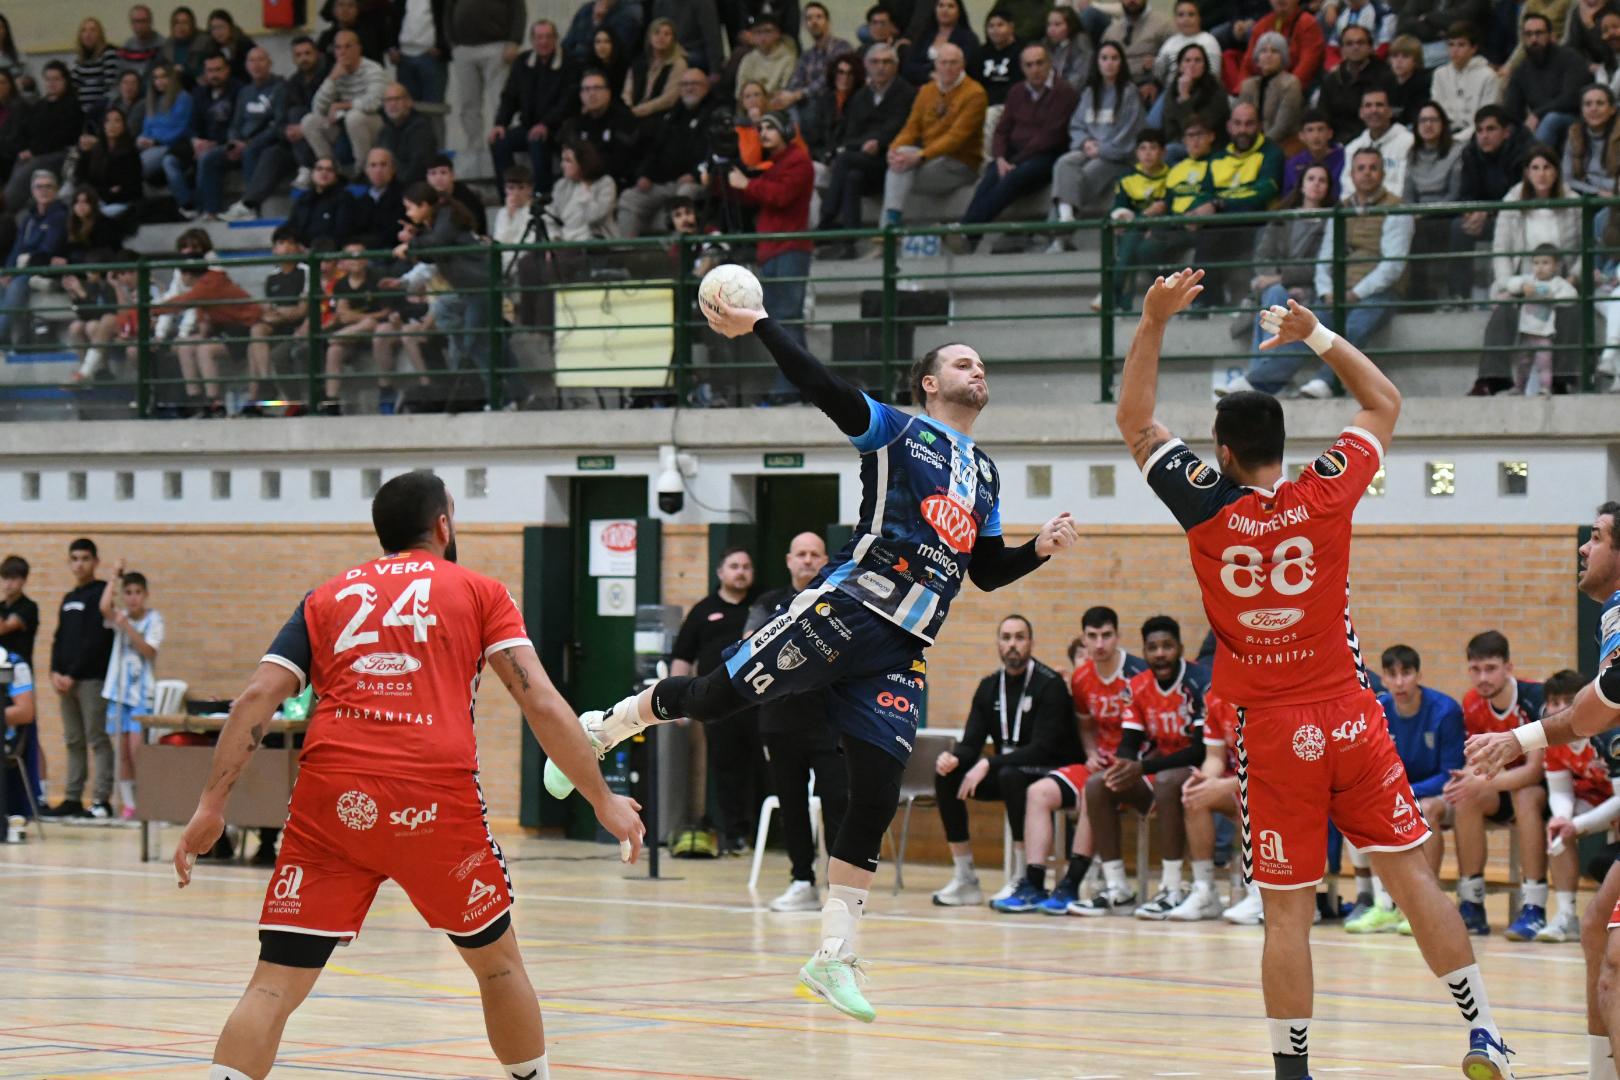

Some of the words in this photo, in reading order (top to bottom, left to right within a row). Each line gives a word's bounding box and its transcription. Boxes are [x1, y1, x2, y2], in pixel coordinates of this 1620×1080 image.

[346, 569, 367, 580] D.
[374, 561, 435, 575] VERA
[1220, 536, 1317, 598] 88
[334, 578, 437, 655] 24
[1251, 612, 1292, 627] Ford
[1246, 633, 1298, 646] MARCOS
[364, 656, 407, 672] Ford
[356, 681, 413, 690] MARCOS
[743, 662, 775, 695] 14
[335, 708, 433, 726] HISPANITAS
[1331, 713, 1368, 743] sGo!
[389, 802, 438, 831] sGo!
[463, 893, 502, 923] Alicante
